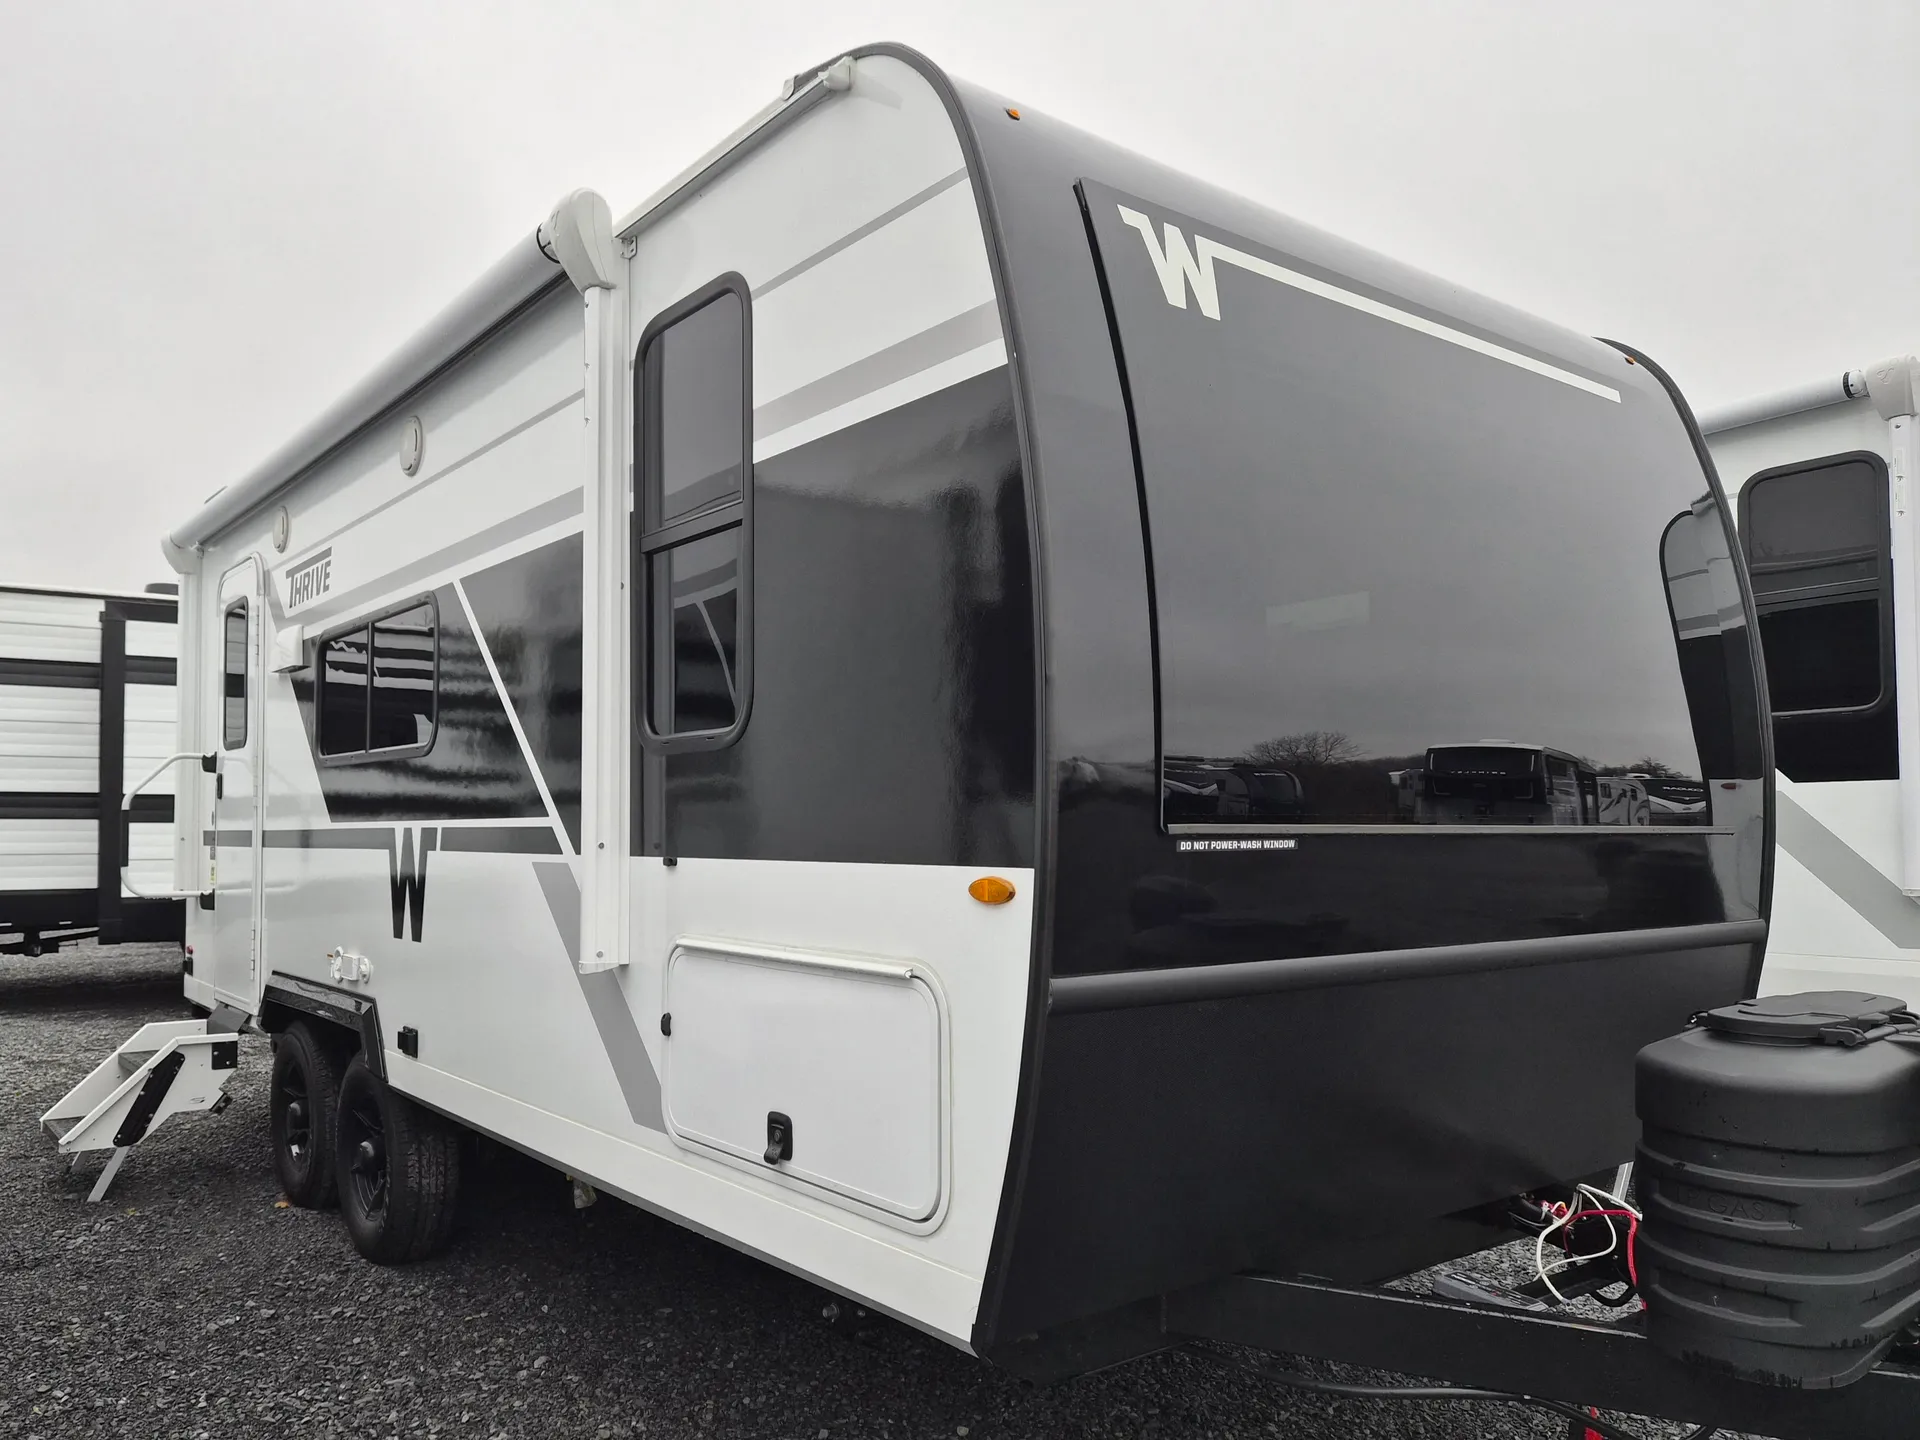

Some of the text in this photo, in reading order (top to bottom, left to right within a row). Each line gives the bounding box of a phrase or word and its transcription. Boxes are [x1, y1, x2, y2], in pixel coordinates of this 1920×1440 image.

[1116, 203, 1221, 321] W
[285, 546, 333, 609] THRIVE
[1180, 839, 1296, 851] DO NOT POWER-WASH WINDOW
